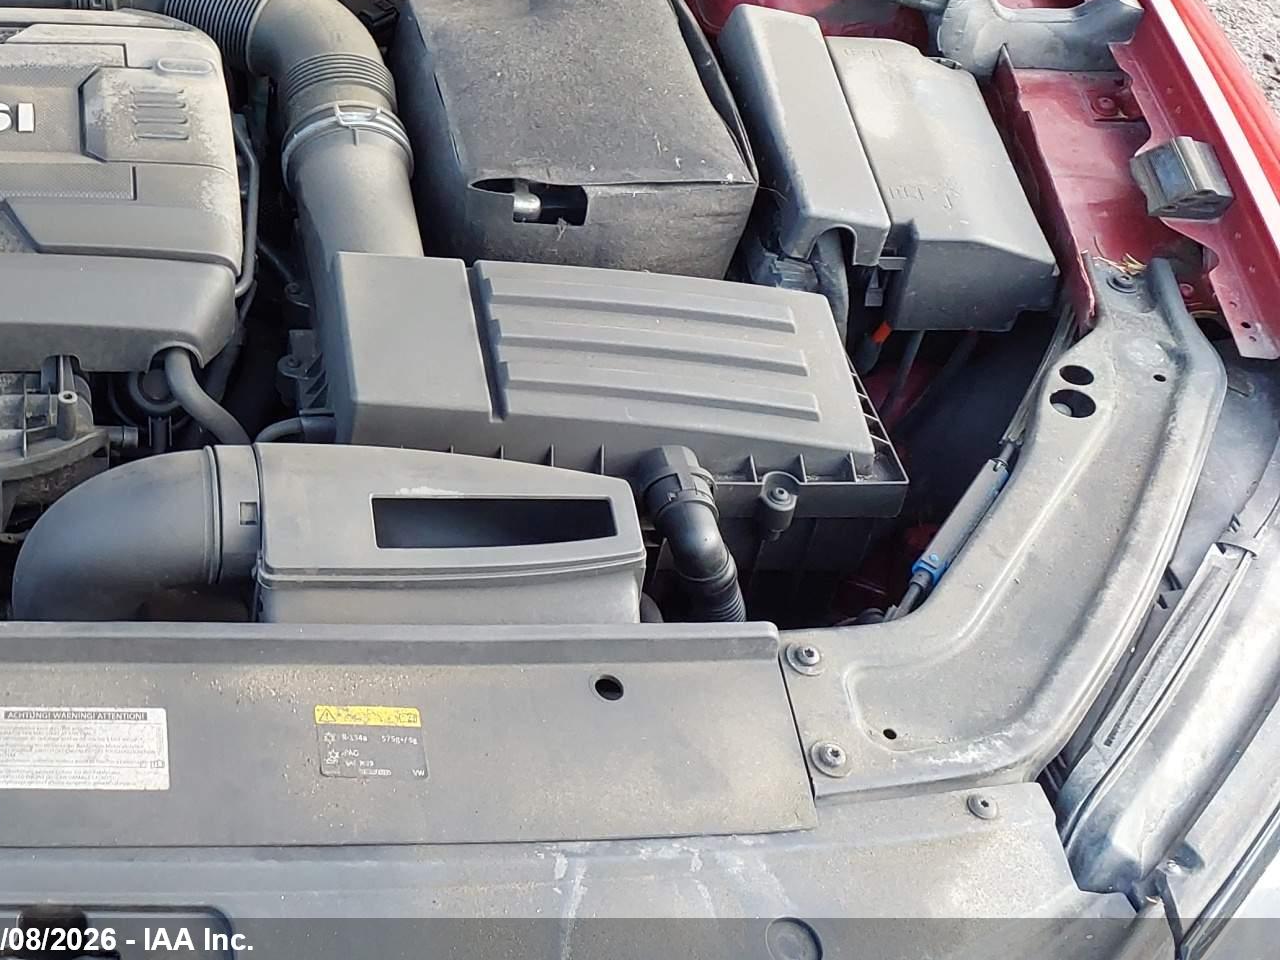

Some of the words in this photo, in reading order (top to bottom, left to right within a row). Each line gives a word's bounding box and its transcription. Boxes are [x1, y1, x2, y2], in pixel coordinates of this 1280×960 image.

[7, 711, 51, 720] ACHTUNG!
[53, 712, 95, 720] WARNING!
[97, 712, 144, 721] ATTENTION!
